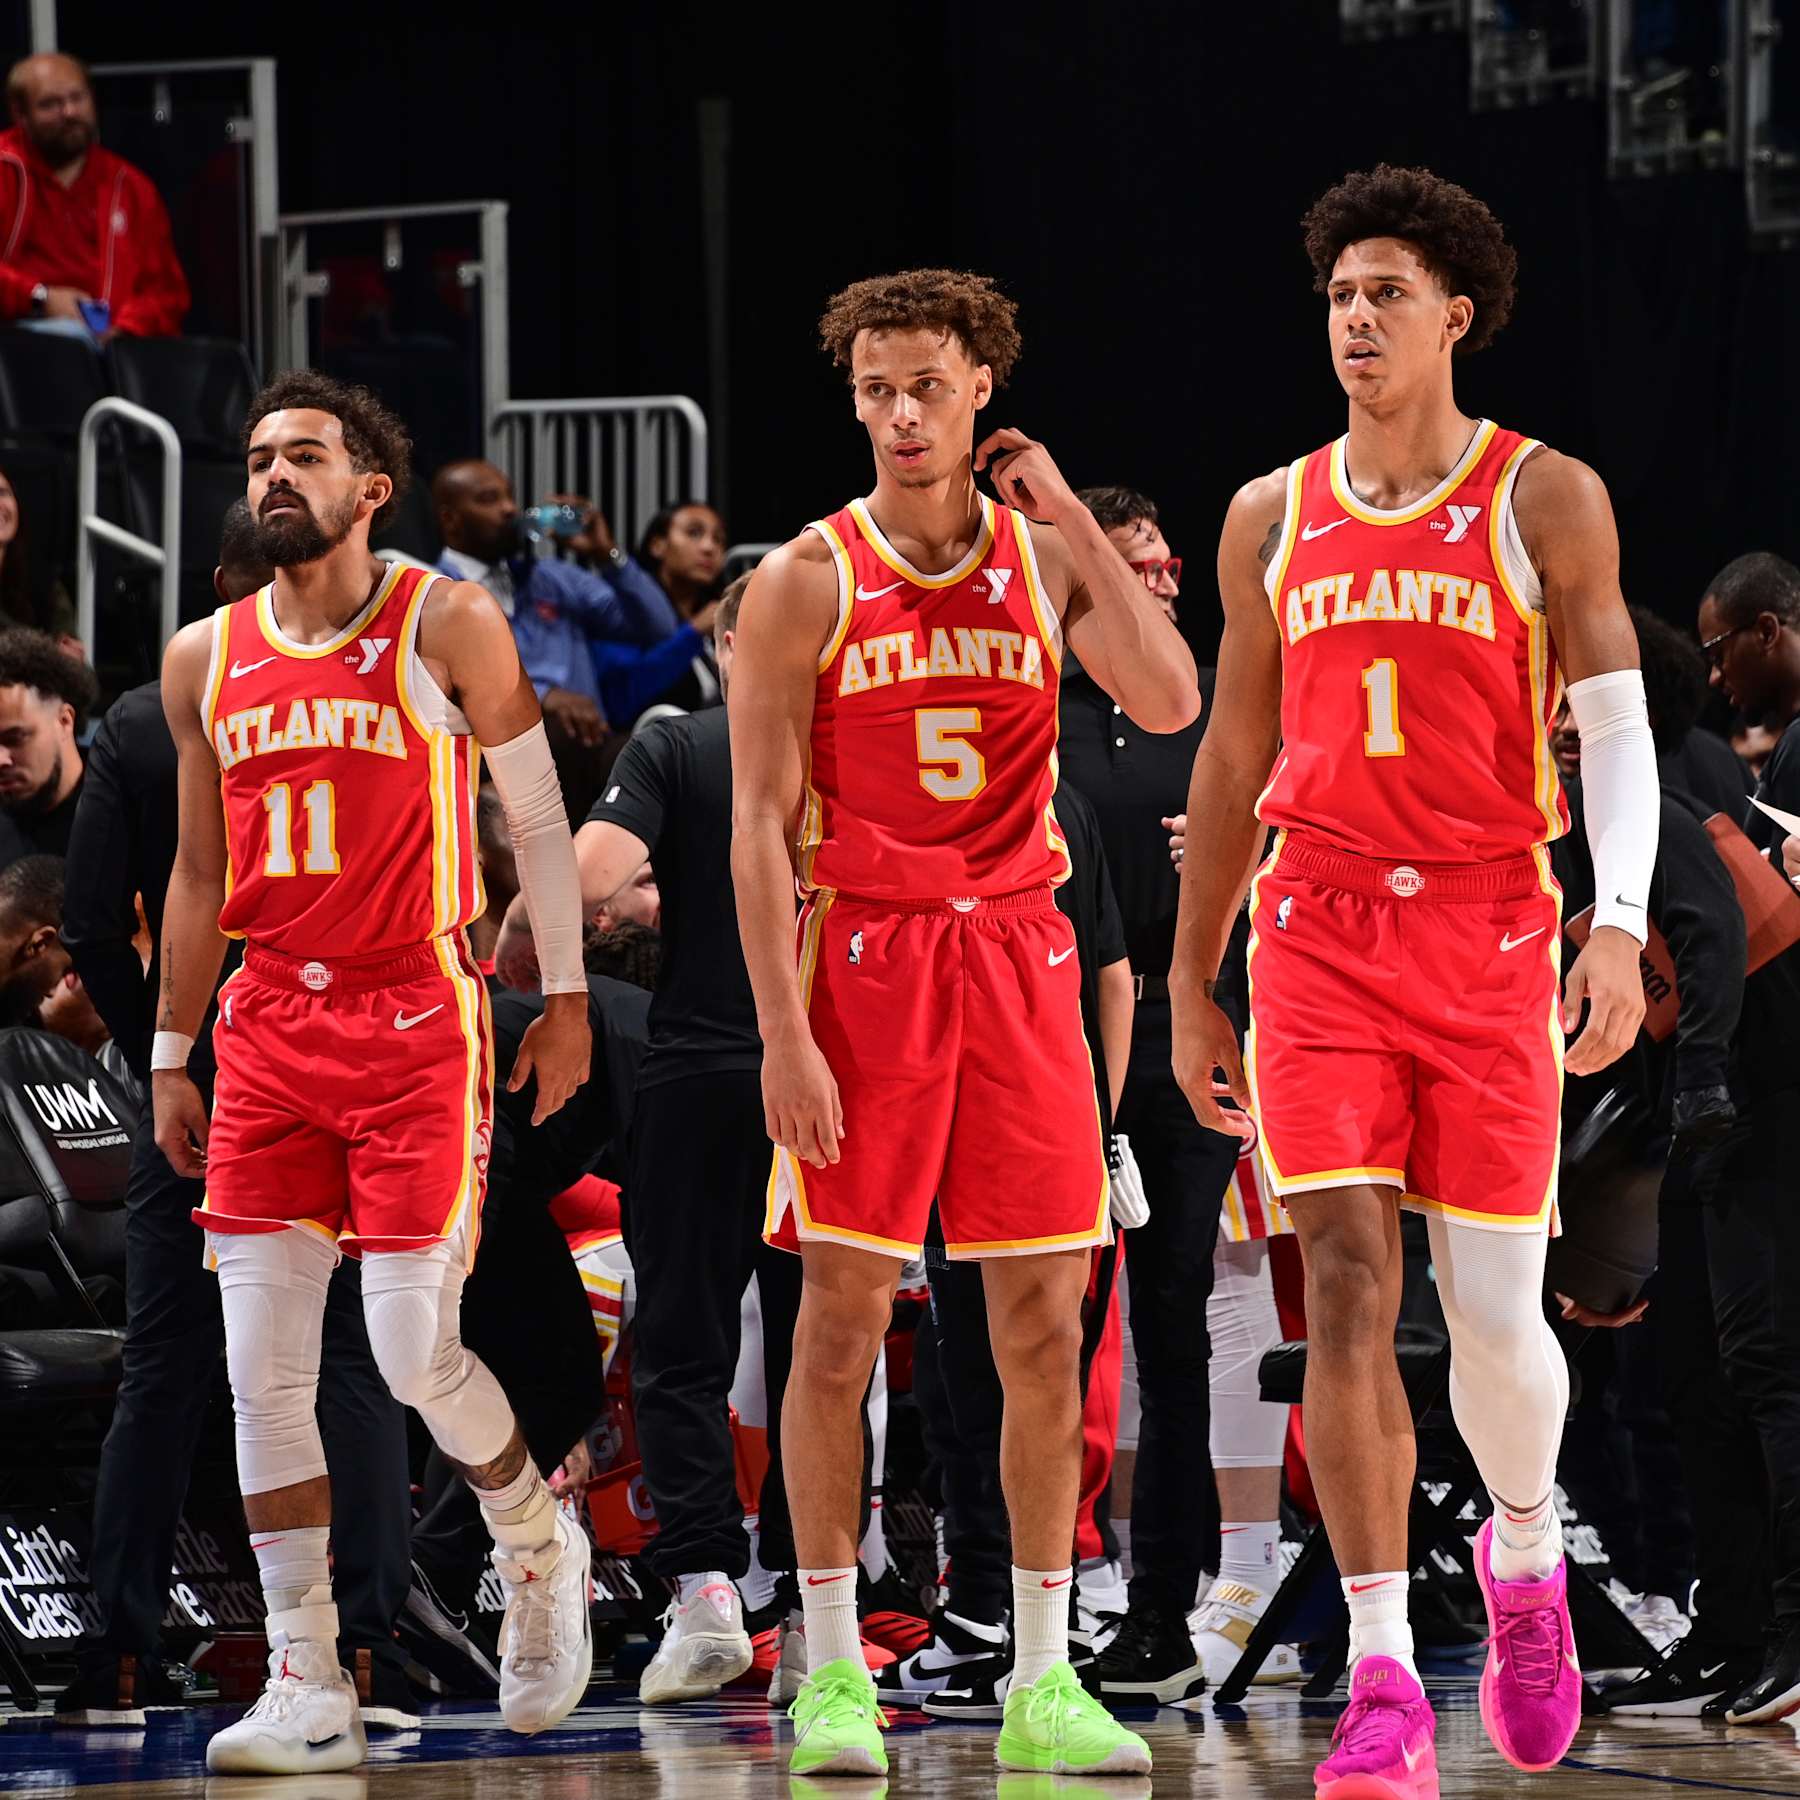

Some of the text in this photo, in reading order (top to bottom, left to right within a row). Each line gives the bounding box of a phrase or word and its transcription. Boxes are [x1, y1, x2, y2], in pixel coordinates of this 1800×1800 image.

[1429, 520, 1447, 532] the
[972, 584, 987, 594] the
[1286, 568, 1497, 648] ATLANTA
[344, 654, 360, 664] the
[838, 627, 1045, 698] ATLANTA
[214, 697, 408, 772] ATLANTA
[1361, 657, 1406, 758] 1
[914, 707, 987, 802] 5
[262, 779, 341, 878] 11
[1385, 873, 1425, 889] HAWKS
[299, 970, 333, 983] HAWKS
[23, 1078, 119, 1131] UWM
